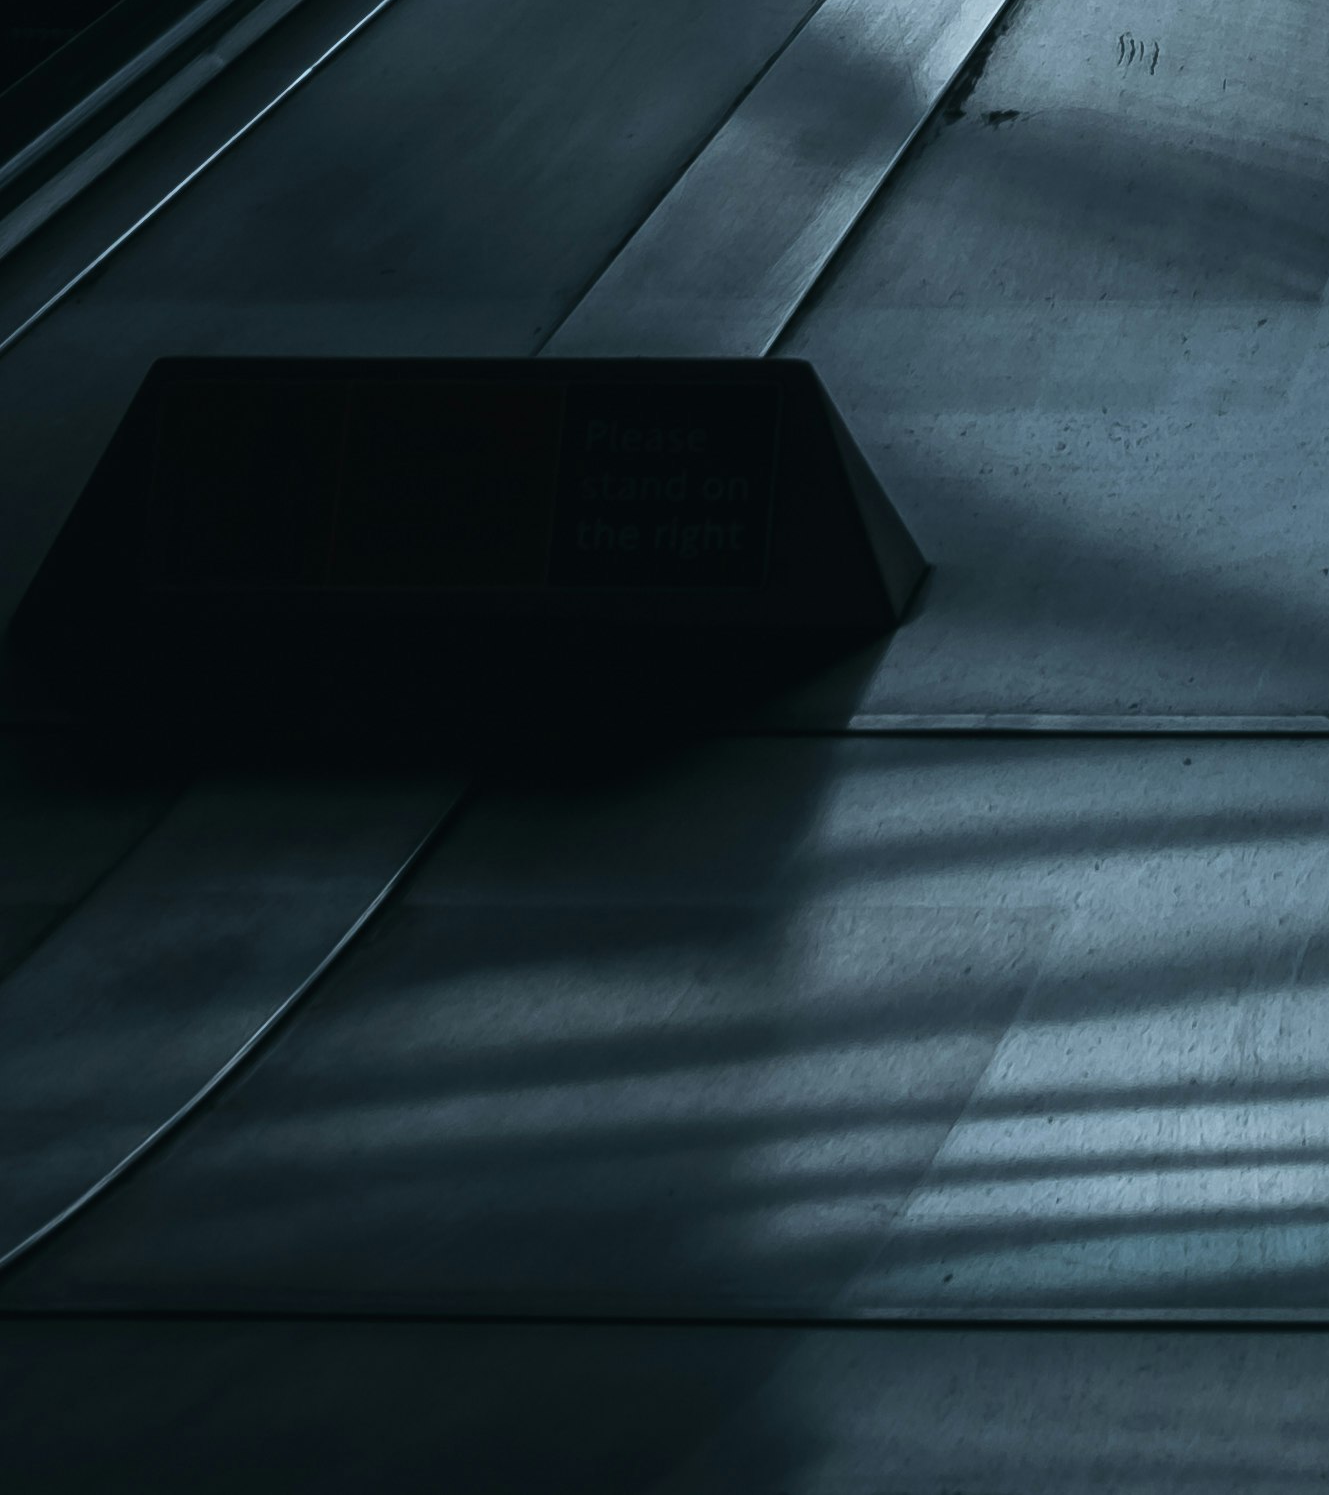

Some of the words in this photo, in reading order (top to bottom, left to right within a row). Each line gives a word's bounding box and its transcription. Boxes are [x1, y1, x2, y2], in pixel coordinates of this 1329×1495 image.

[584, 419, 708, 454] Please
[580, 468, 689, 503] stand
[700, 473, 751, 503] on
[575, 516, 642, 552] the
[653, 516, 744, 561] right
